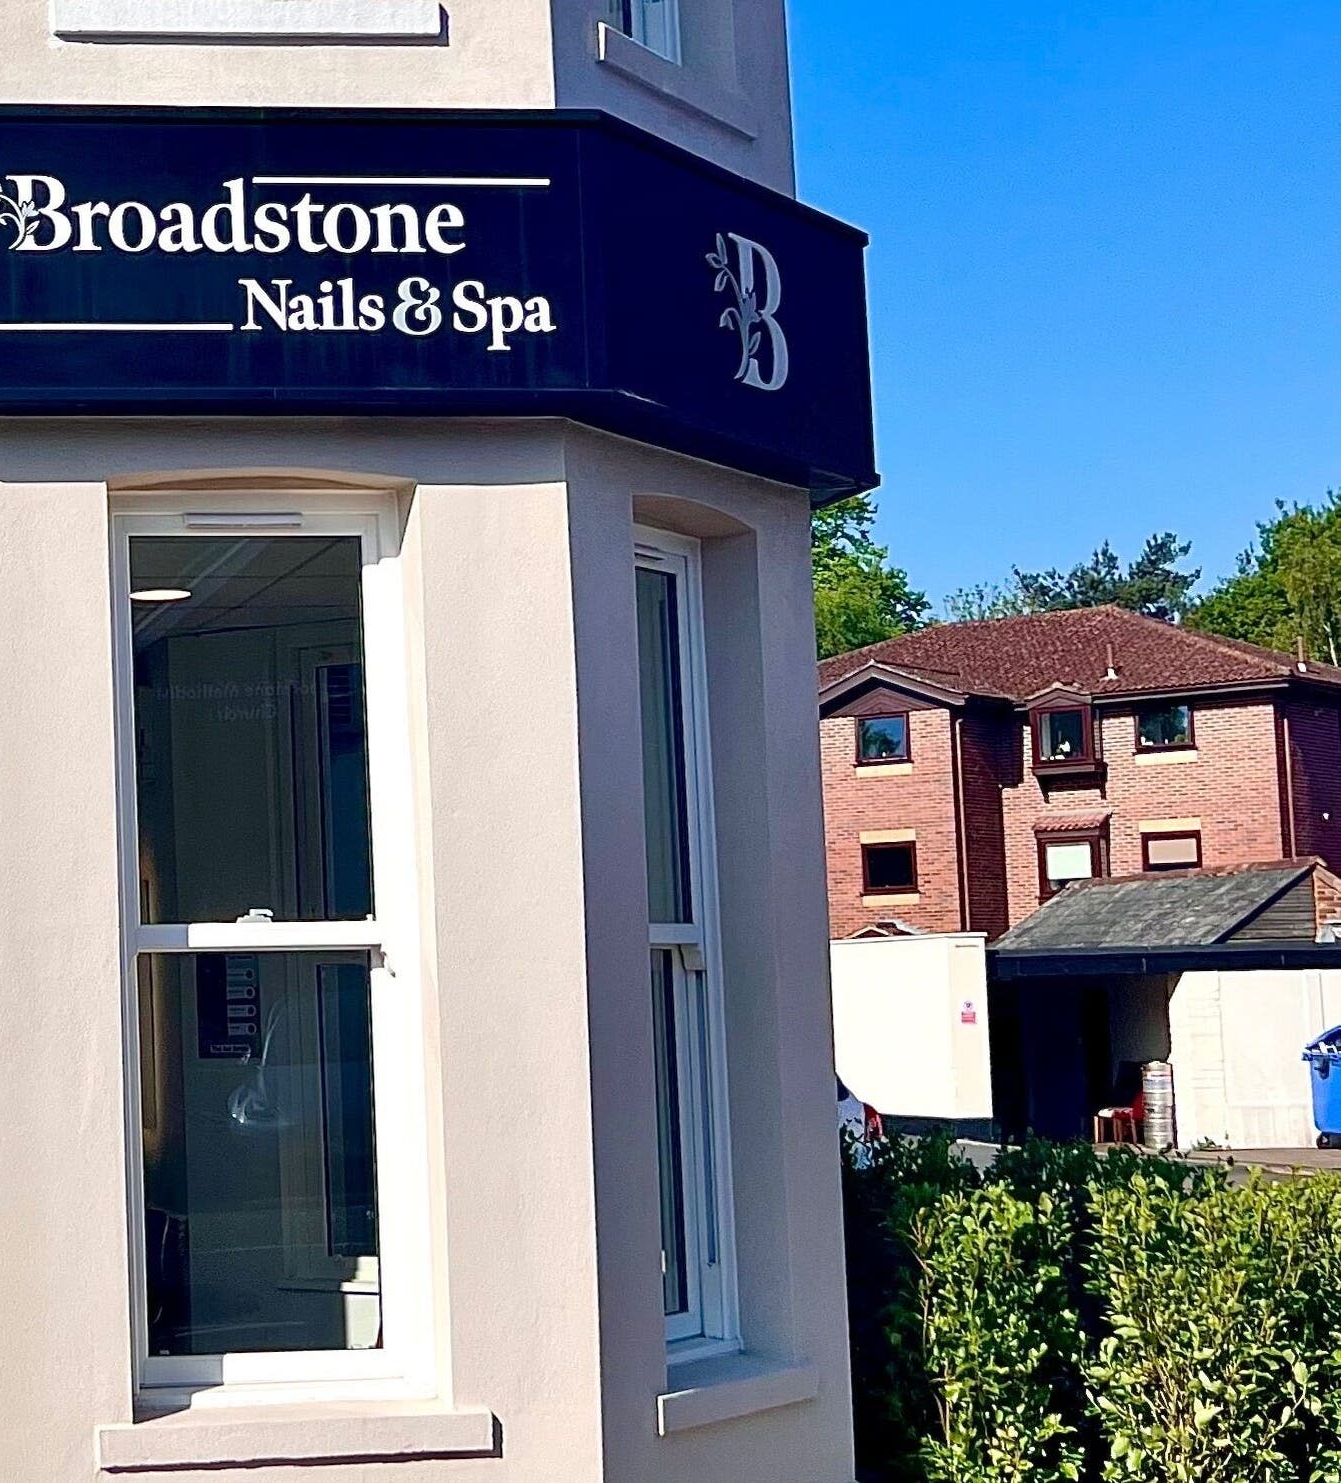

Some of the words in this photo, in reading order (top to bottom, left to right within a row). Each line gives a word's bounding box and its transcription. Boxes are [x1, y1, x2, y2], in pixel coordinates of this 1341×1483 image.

[5, 174, 467, 256] Broadstone
[238, 278, 385, 330] Nails
[393, 277, 441, 335] &
[453, 281, 556, 350] Spa
[717, 231, 790, 392] B
